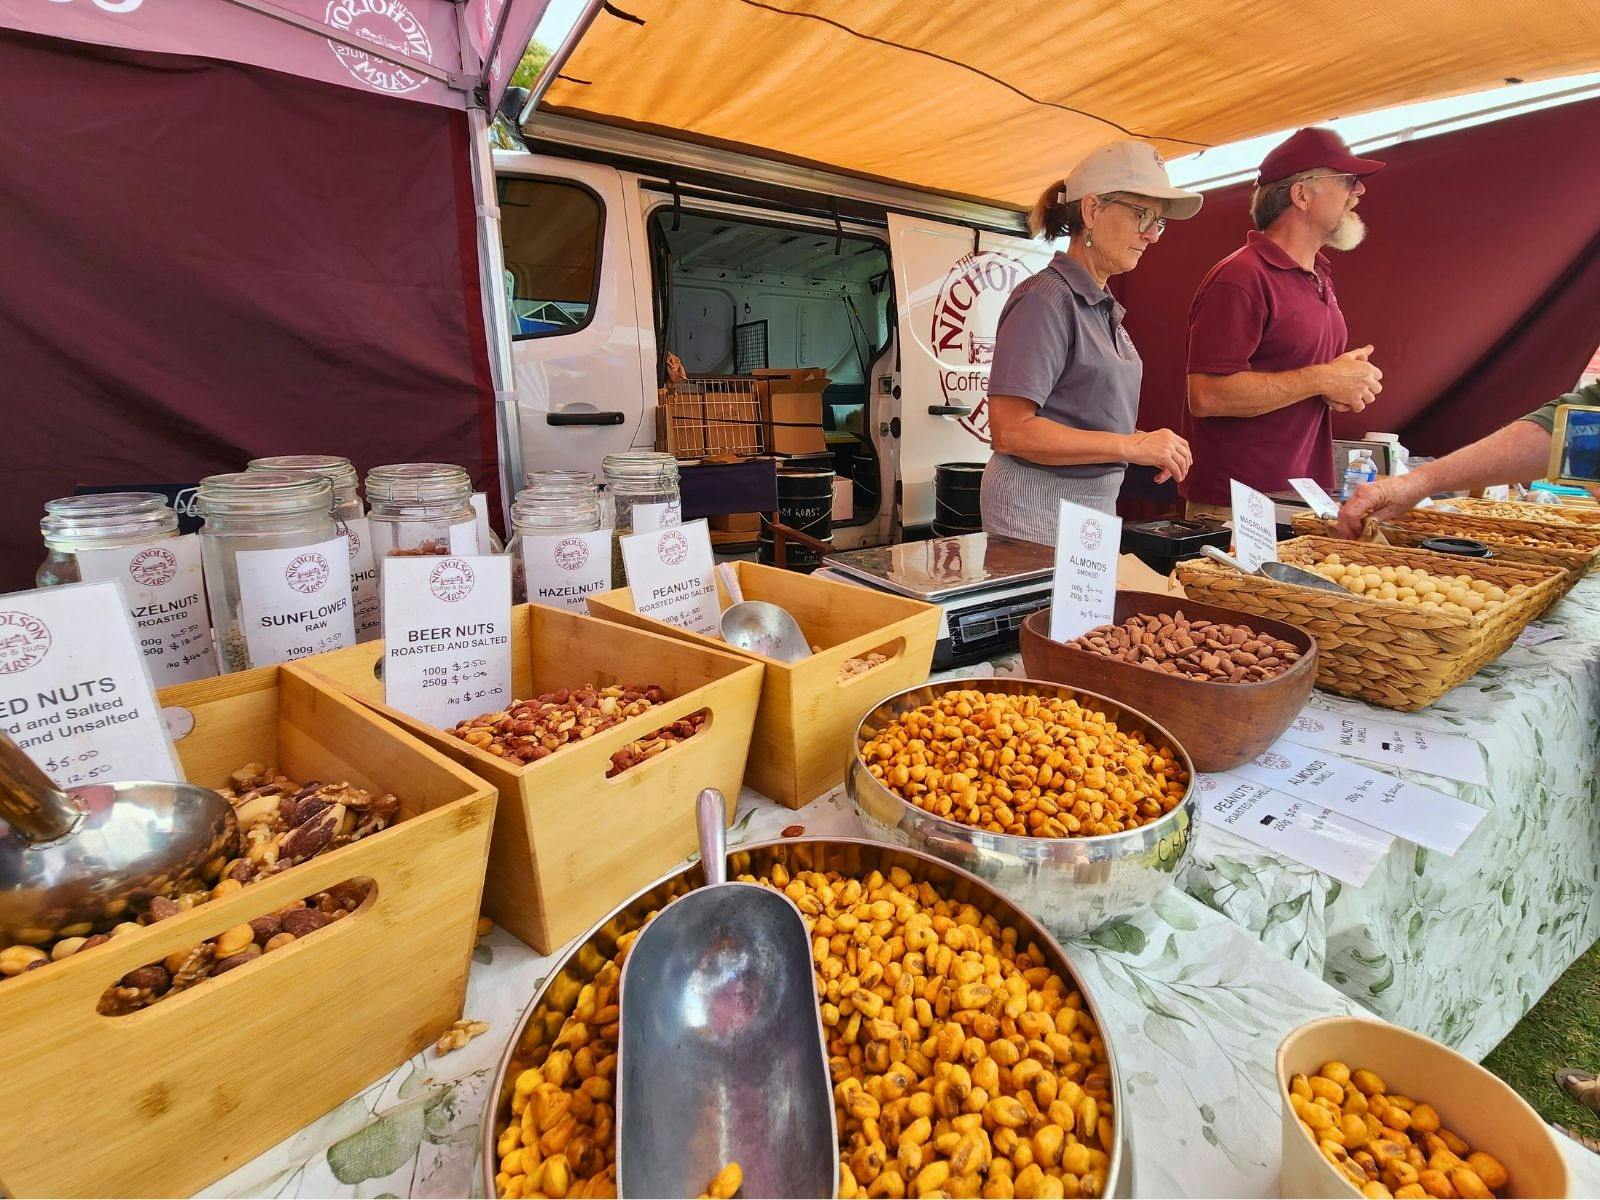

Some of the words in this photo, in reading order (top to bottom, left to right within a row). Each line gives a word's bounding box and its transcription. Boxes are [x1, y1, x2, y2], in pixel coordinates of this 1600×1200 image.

[955, 251, 977, 273] THE
[132, 550, 175, 572] NICHOLSON
[288, 555, 328, 578] NICHOLSON
[431, 560, 473, 584] NICHOLSON
[1069, 554, 1107, 573] ALMONDS
[143, 573, 171, 586] FARM
[1076, 568, 1099, 580] SMOKED
[298, 580, 324, 593] FARM
[440, 589, 466, 601] FARM
[538, 579, 604, 597] HAZELNUTS
[652, 577, 701, 600] PEANUTS
[566, 596, 585, 605] RAW
[639, 597, 675, 614] ROASTED
[675, 592, 690, 603] AND
[690, 584, 716, 598] SALTED
[138, 611, 188, 628] ROASTED
[261, 597, 348, 628] SUNFLOWER
[305, 619, 328, 632] RAW
[408, 627, 451, 642] BEER
[456, 622, 495, 638] NUTS
[22, 643, 48, 656] Nuts
[286, 646, 314, 656] 100g
[391, 643, 445, 657] ROASTED
[447, 640, 470, 651] AND
[471, 635, 508, 648] SALTED
[423, 666, 447, 676] 100g
[37, 676, 118, 709] NUTS
[422, 677, 447, 688] 250g
[26, 712, 61, 730] and
[66, 696, 124, 719] Salted
[19, 730, 55, 749] and
[58, 708, 140, 739] Unsalted
[1340, 719, 1354, 746] WALNUTS
[1288, 759, 1327, 787] ALMONDS
[1213, 784, 1254, 814] PEANUTS
[1224, 801, 1253, 825] ROASTED
